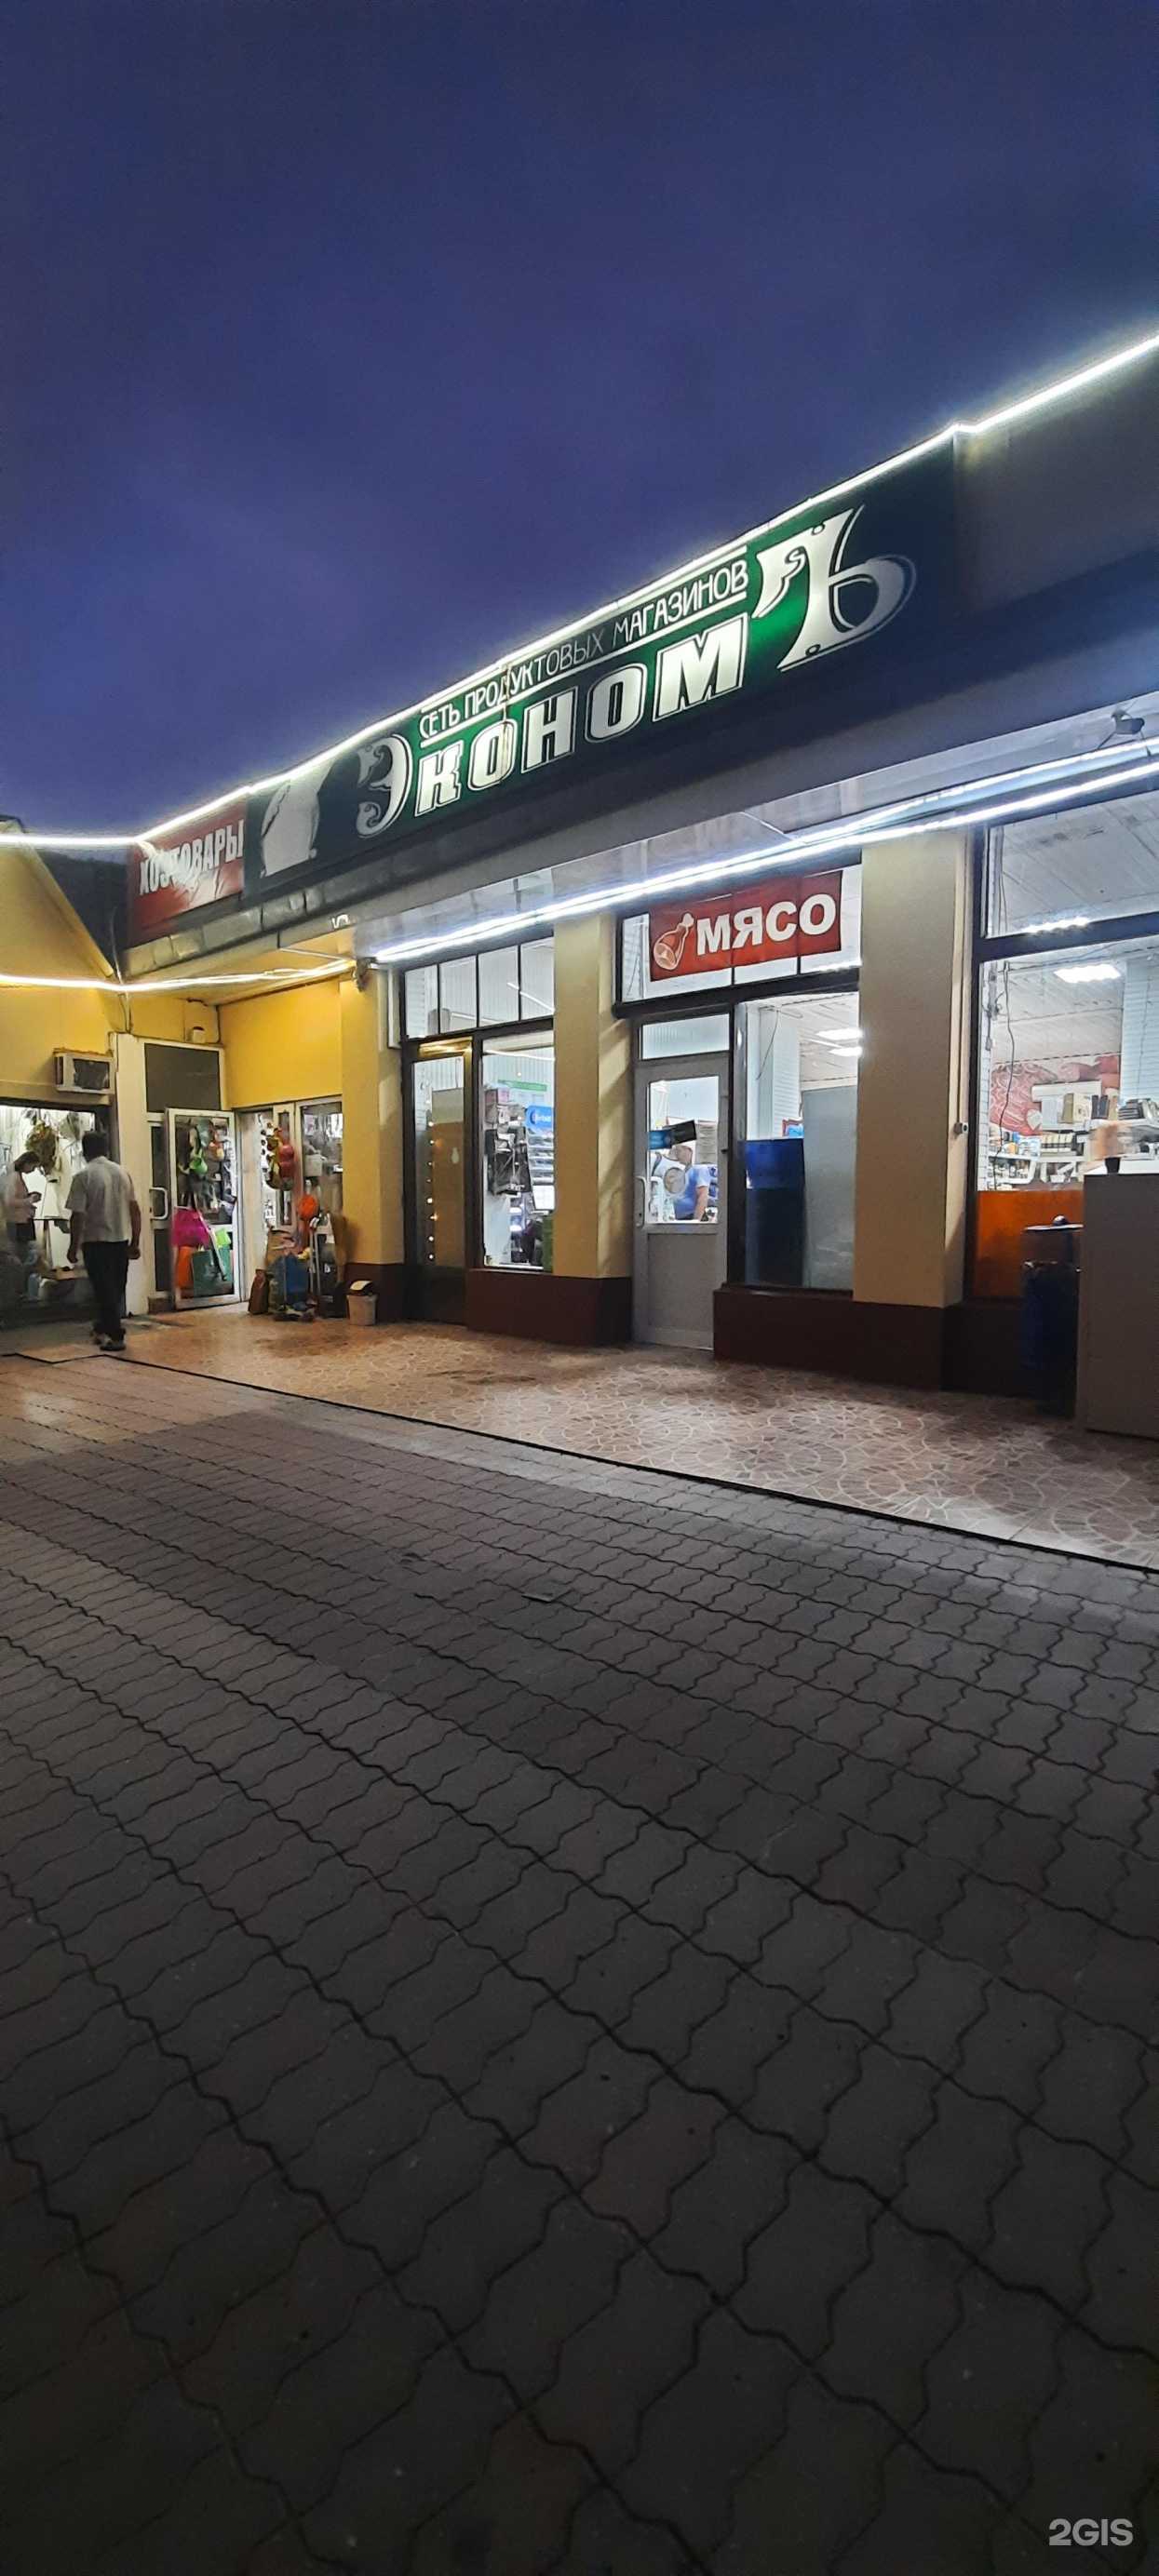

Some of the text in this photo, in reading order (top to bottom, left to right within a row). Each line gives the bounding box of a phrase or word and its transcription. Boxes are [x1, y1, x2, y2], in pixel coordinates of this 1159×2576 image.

[419, 559, 748, 739] СЕТЬ ПРОДУКТОВЫХ МАГАЗИНОВ
[696, 893, 836, 956] МЯСО
